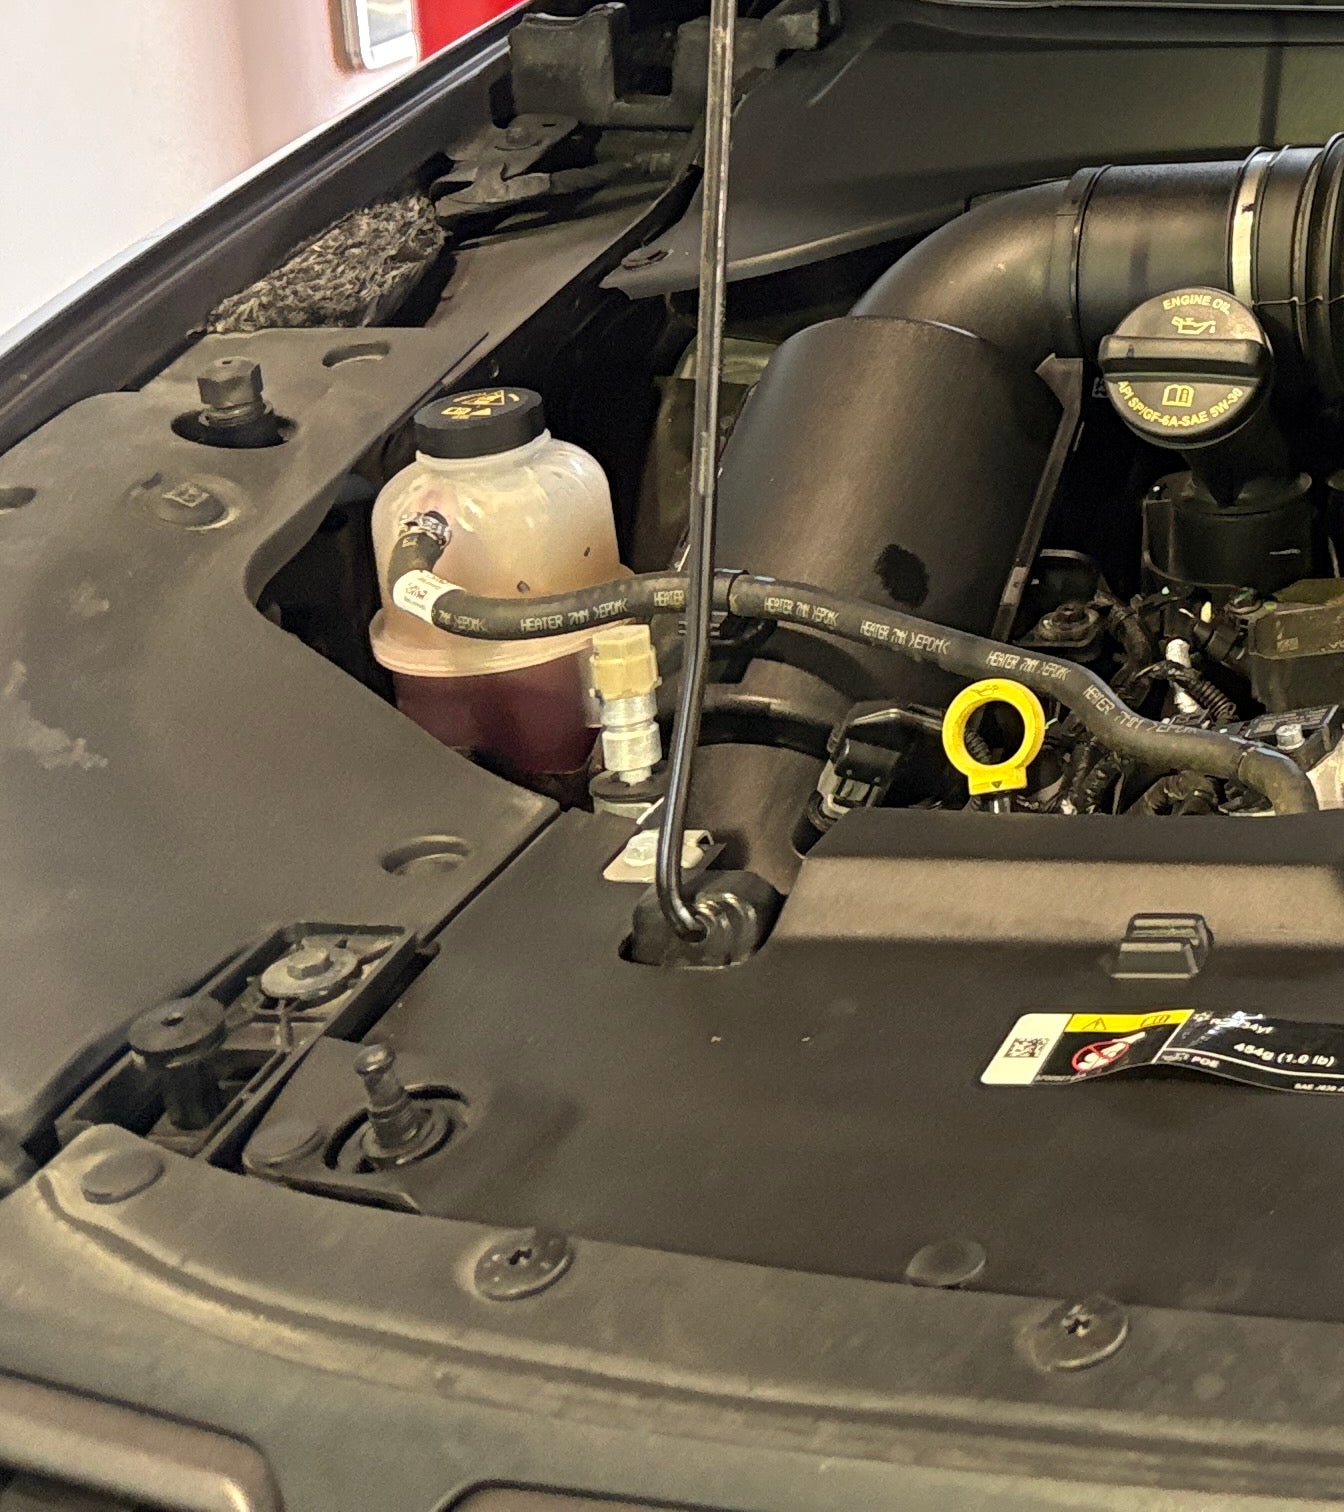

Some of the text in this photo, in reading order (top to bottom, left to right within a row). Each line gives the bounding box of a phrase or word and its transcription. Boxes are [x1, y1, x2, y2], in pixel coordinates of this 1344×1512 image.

[1163, 294, 1231, 315] ENGINE OIL
[1118, 381, 1133, 397] API
[1210, 388, 1243, 417] 5W-30
[654, 590, 685, 606] HEATER
[764, 597, 793, 615] HEATER
[520, 615, 563, 632] HEATER
[860, 619, 890, 641] HEATER
[986, 650, 1018, 670] HEATER
[1084, 684, 1116, 715] HEATER
[1191, 1056, 1220, 1069] POE
[1233, 1042, 1335, 1068] 454g (1.0 lb)
